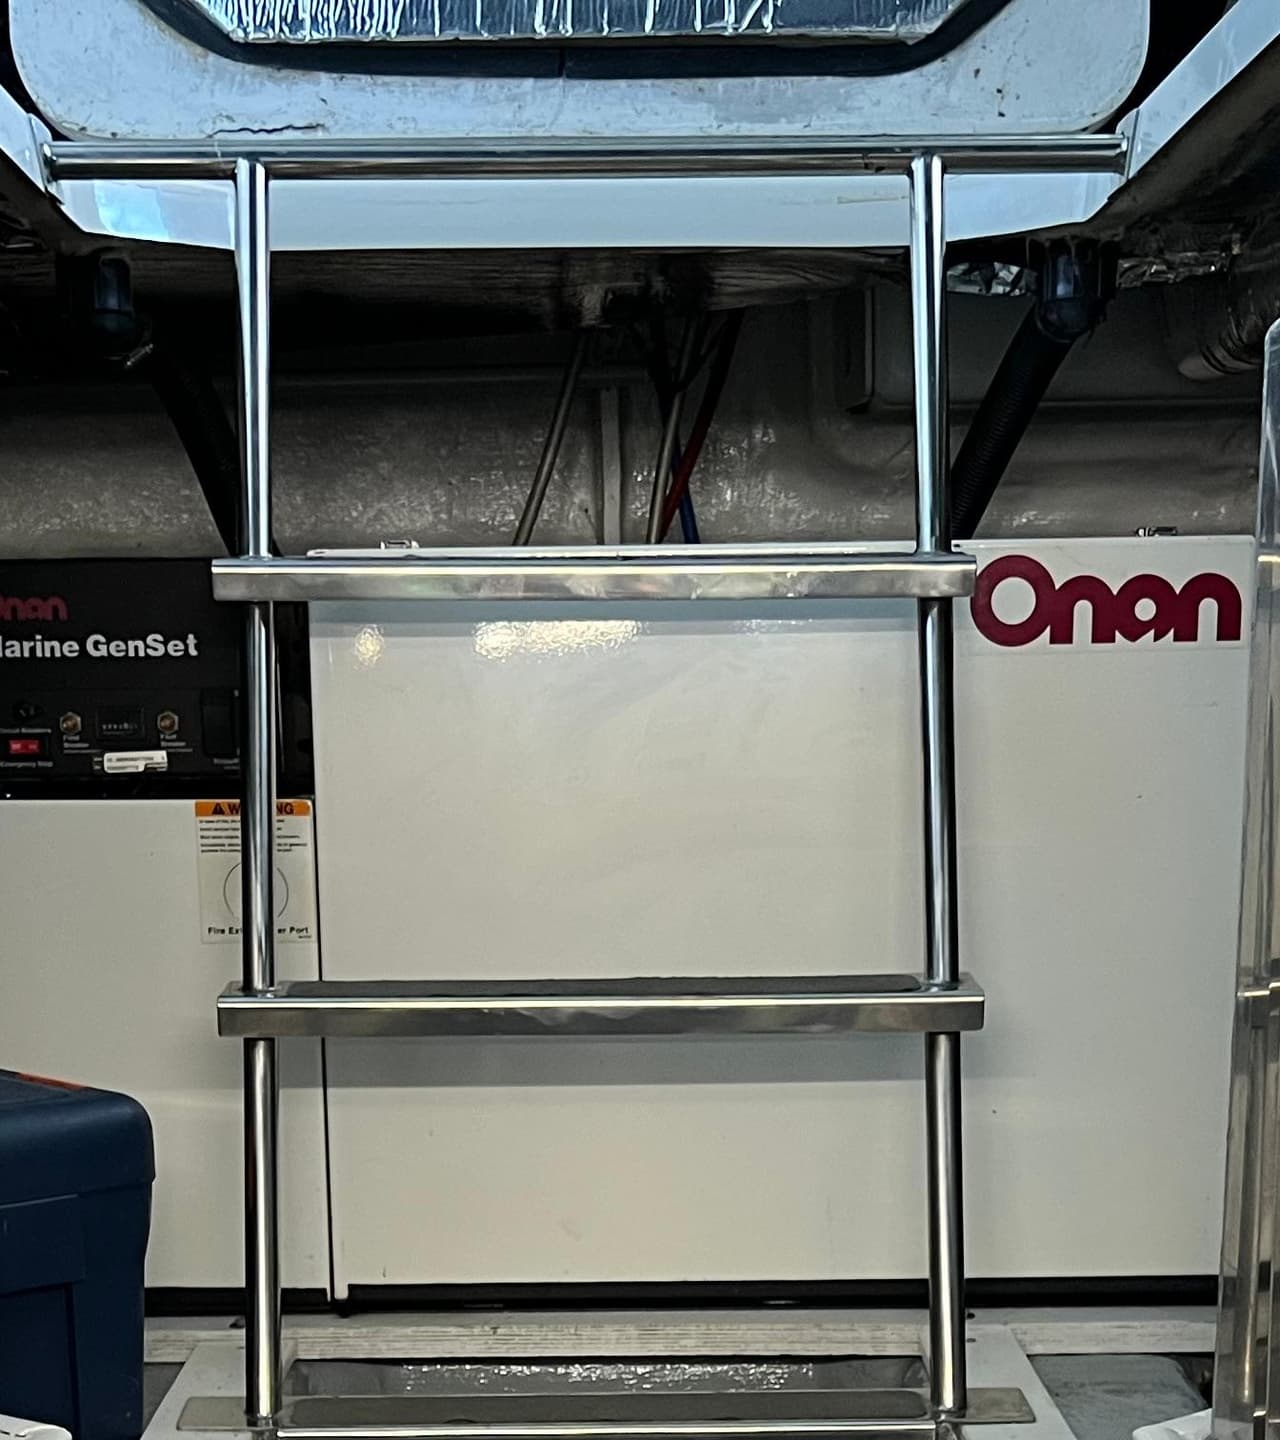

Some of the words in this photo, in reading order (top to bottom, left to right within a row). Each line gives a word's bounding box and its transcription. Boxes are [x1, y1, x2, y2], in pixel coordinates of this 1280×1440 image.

[970, 554, 1241, 647] Onan
[86, 633, 198, 657] GenSet
[208, 927, 225, 935] Fire
[289, 926, 309, 934] Port
